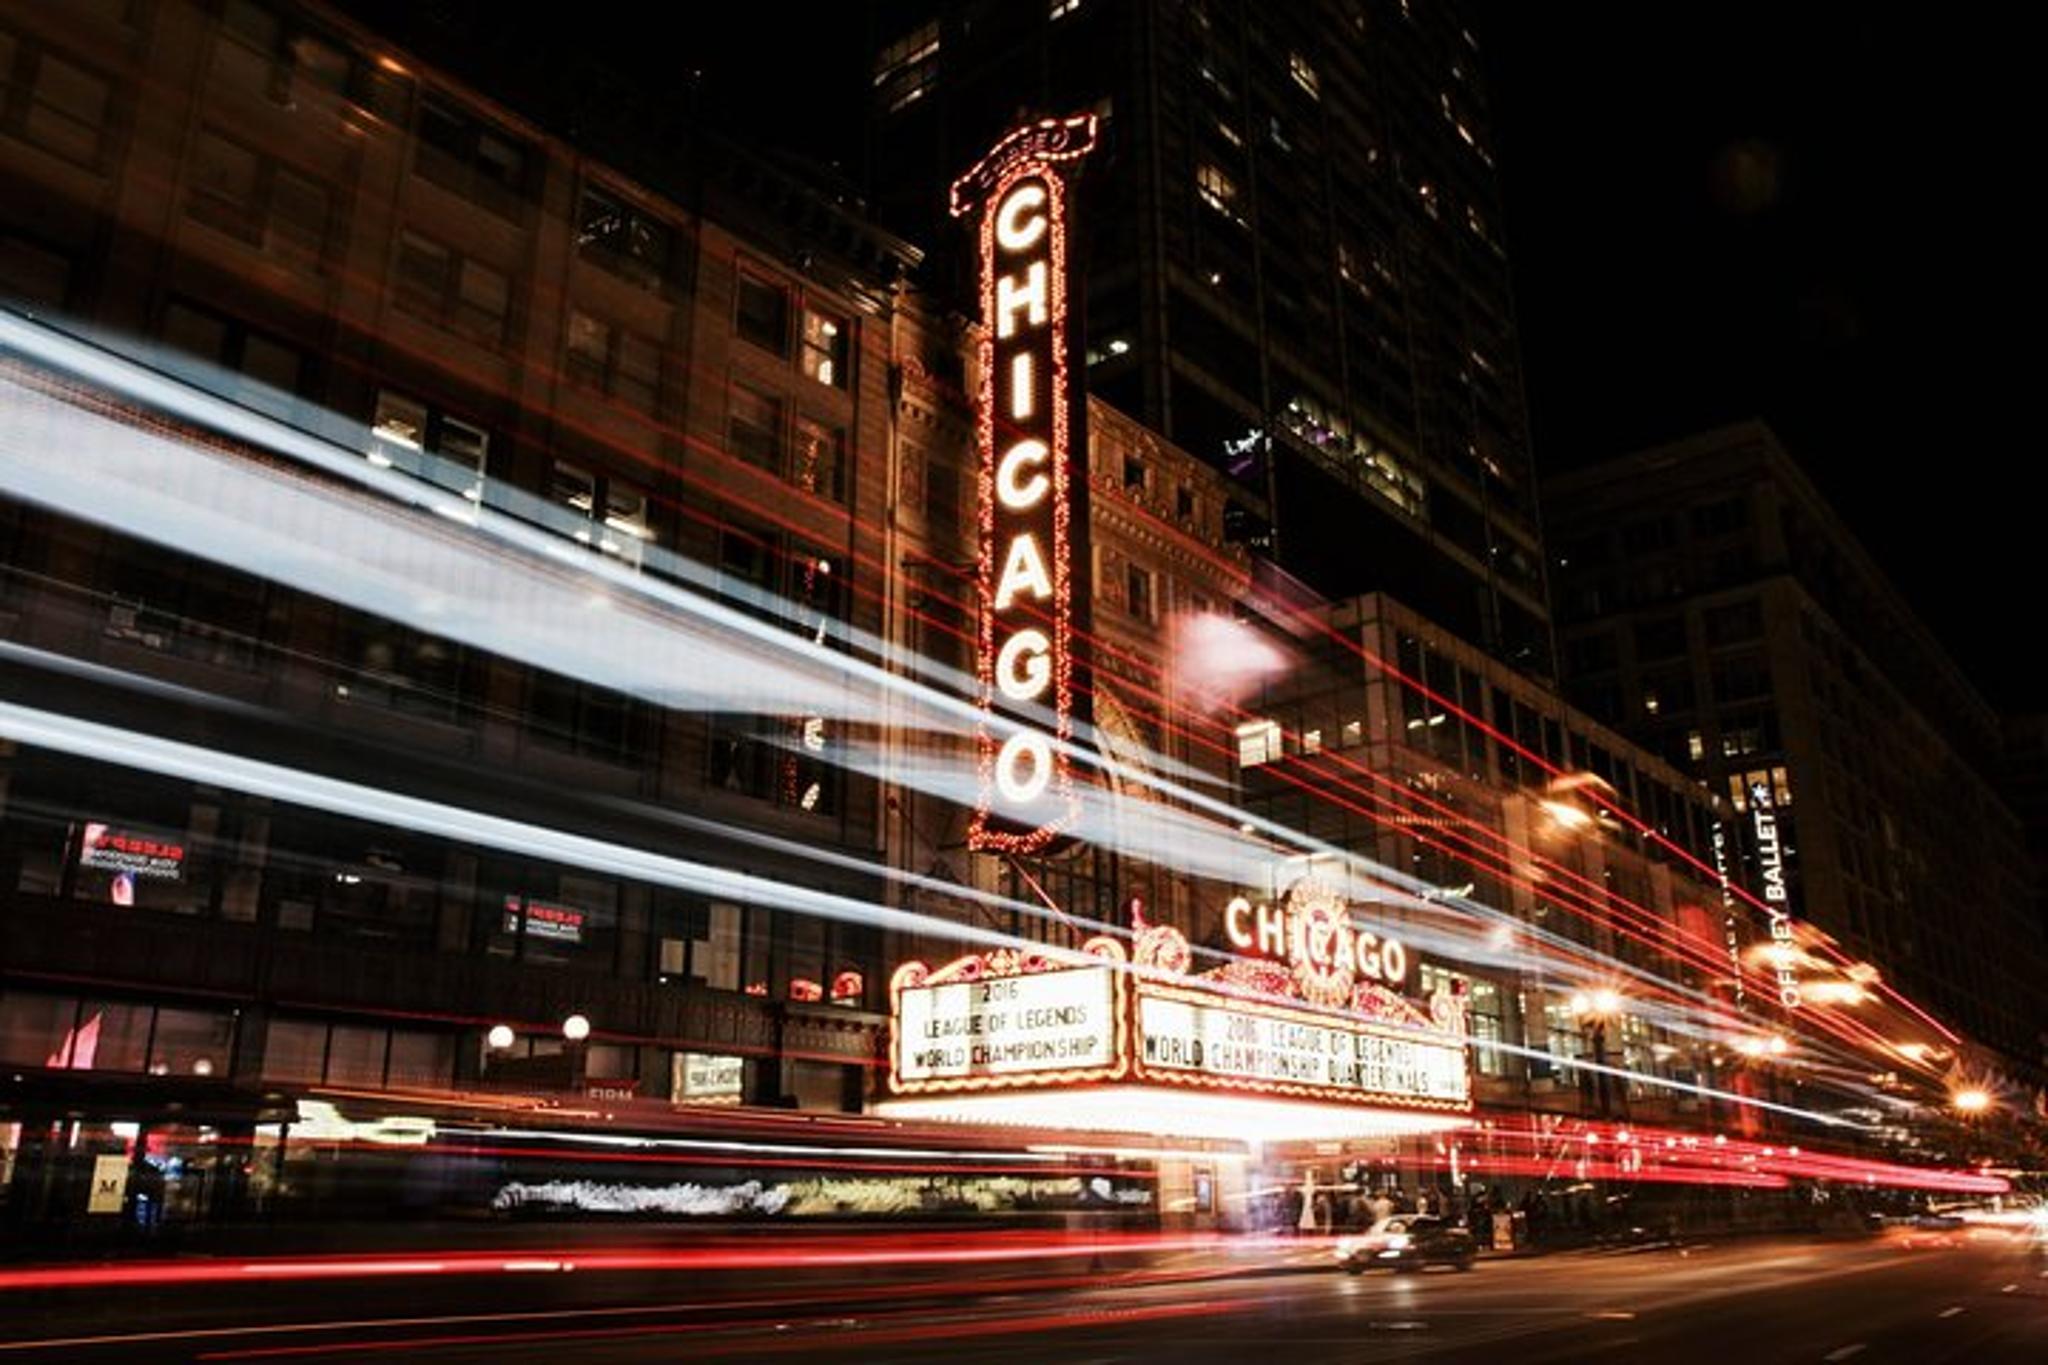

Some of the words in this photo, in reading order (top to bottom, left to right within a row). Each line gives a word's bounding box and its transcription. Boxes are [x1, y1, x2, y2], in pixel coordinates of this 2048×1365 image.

[996, 186, 1051, 804] CHICAGO
[1754, 810, 1787, 900] BALLET
[1225, 897, 1406, 982] CHICAGO
[983, 981, 1019, 1002] 2016
[924, 1014, 983, 1039] LEAGUE
[989, 1013, 1007, 1033] OF
[1017, 1005, 1088, 1031] LEGENDS
[1271, 1022, 1323, 1053] LEAGUE
[1330, 1032, 1347, 1056] OF
[1353, 1035, 1411, 1065] LEGENDS
[914, 1049, 965, 1068] WORLD
[971, 1036, 1099, 1065] CHAMPIONSHIP
[1145, 1034, 1204, 1068] WORLD
[1211, 1042, 1319, 1080] CHAMPIONSHIP
[1328, 1059, 1429, 1093] QUARTERFINALS
